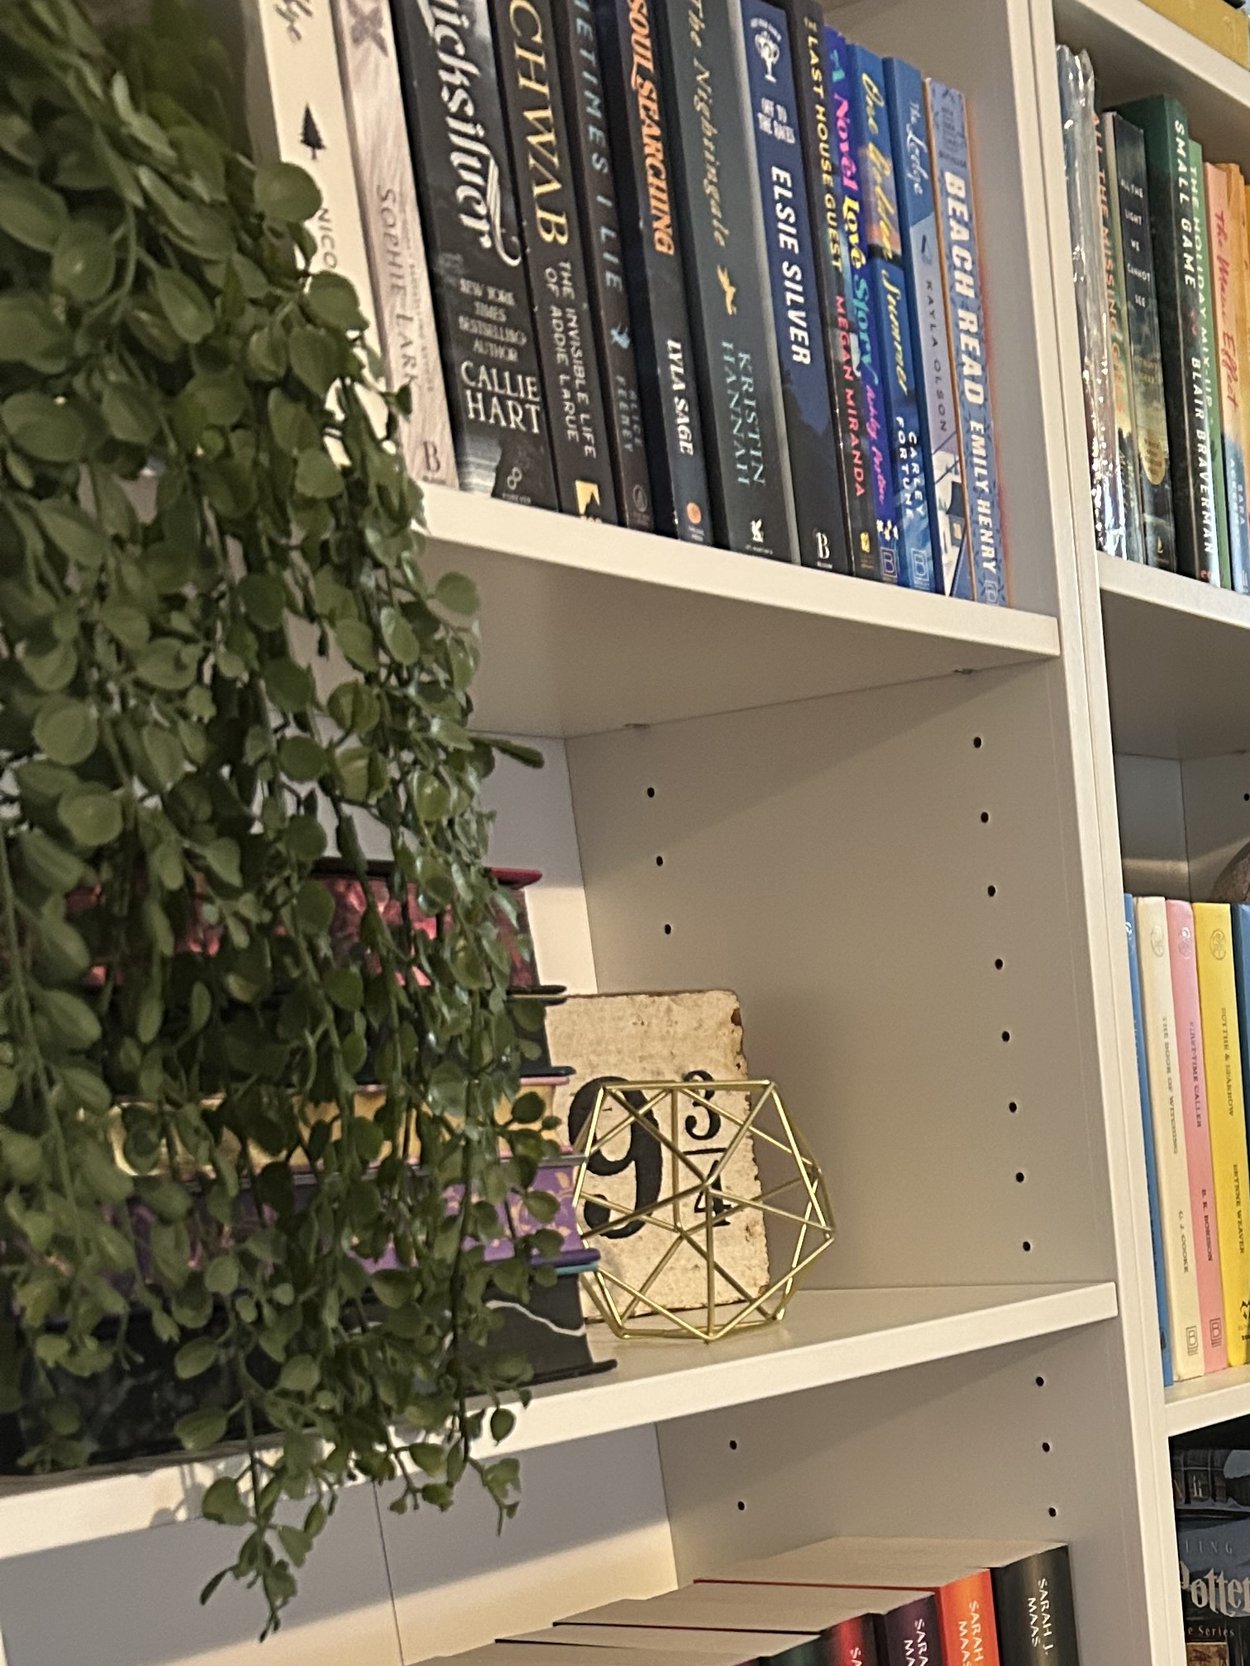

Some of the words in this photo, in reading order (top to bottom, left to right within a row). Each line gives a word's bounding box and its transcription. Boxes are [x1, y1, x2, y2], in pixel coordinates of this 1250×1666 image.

[807, 36, 824, 98] LAST
[418, 0, 522, 266] icksilver
[636, 78, 675, 256] SEARCHING
[693, 57, 730, 248] Nightingale
[815, 104, 834, 187] HOUSE
[834, 93, 859, 191] Novel
[1174, 119, 1191, 205] SMALL
[377, 184, 407, 295] SOPHIE
[771, 166, 800, 254] ELSIE
[824, 193, 844, 273] GUEST
[843, 195, 867, 269] Love
[944, 171, 977, 302] BEACH
[545, 267, 561, 298] OF
[559, 261, 576, 301] THE
[600, 226, 624, 293] LIE
[1181, 217, 1197, 290] GAME
[550, 305, 570, 367] ADDIE
[782, 261, 811, 366] SILVER
[853, 273, 879, 386] Story
[925, 280, 940, 348] KAYLA
[460, 360, 541, 402] CALLIE
[565, 307, 590, 405] INVISIBLE
[666, 338, 687, 392] LYLA
[957, 306, 985, 406] READ
[1191, 356, 1205, 420] BLAIR
[465, 389, 541, 434] HART
[560, 375, 580, 443] LARUE
[674, 396, 694, 457] SAGE
[721, 340, 750, 486] HANNAH
[738, 352, 768, 487] KRISTIN
[836, 295, 854, 381] MEGAN
[845, 388, 865, 497] MIRANDA
[931, 361, 949, 434] OLSON
[580, 413, 597, 459] LIFE
[969, 420, 989, 500] EMILY
[1196, 430, 1217, 554] BRAVERMAN
[976, 504, 997, 575] HENRY
[567, 1075, 663, 1239] 9
[969, 1600, 984, 1662] SARAH
[1028, 1597, 1041, 1648] MAAS
[1038, 1578, 1053, 1637] SARAH
